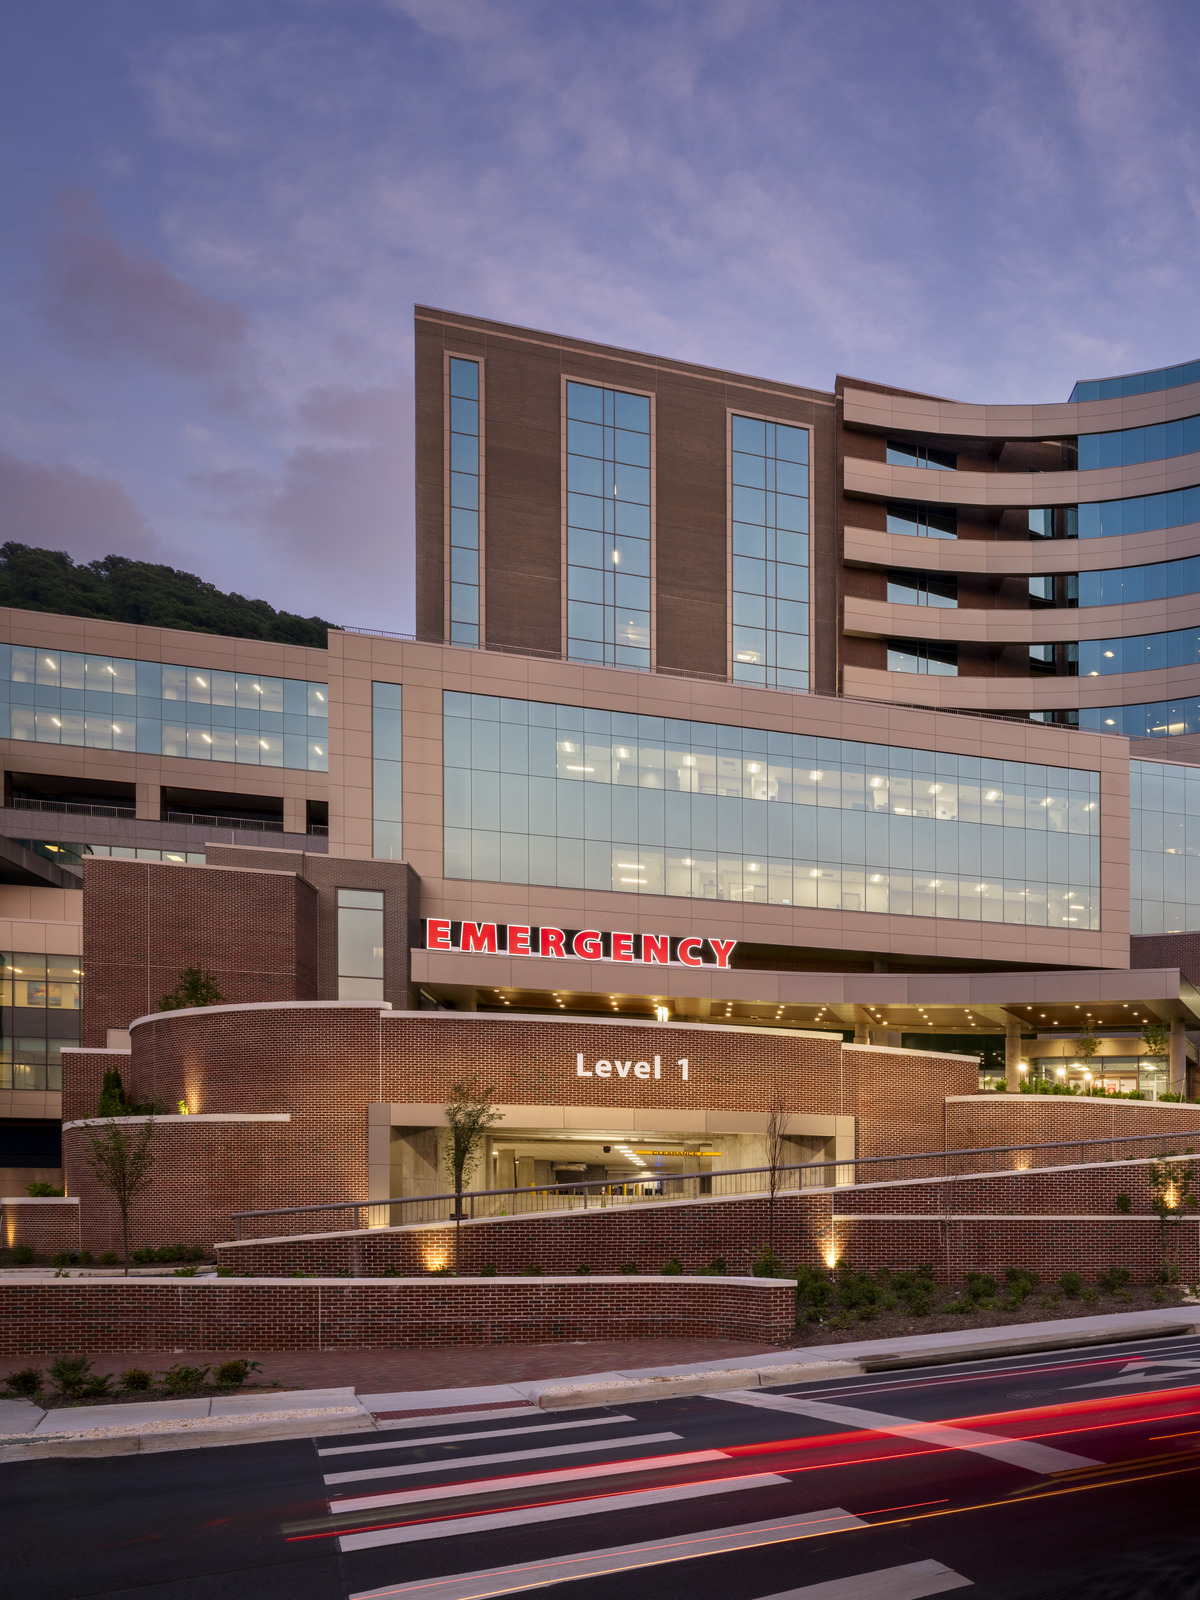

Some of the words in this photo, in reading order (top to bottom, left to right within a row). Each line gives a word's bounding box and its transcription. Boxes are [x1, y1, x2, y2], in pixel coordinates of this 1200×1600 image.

[426, 917, 737, 969] EMERGENCY
[576, 1053, 661, 1080] Level
[677, 1058, 690, 1081] 1
